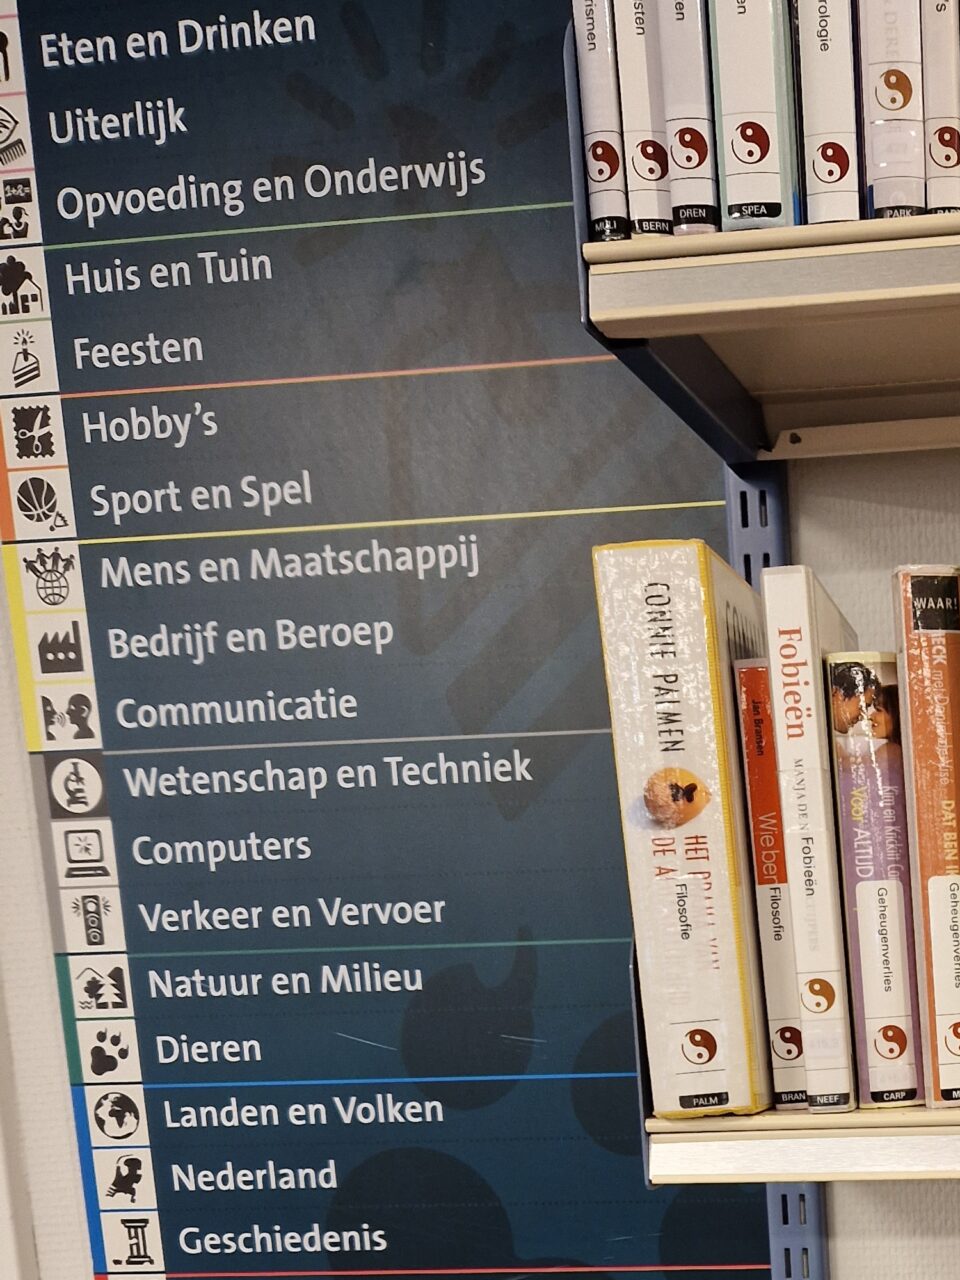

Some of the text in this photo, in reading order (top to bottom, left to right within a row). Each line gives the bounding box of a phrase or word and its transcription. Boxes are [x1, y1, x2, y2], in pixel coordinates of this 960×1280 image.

[41, 10, 315, 67] Eten en Drinken
[49, 98, 187, 145] Uiterlijk
[57, 151, 485, 228] Opvoeding en Onderwijs
[742, 204, 767, 216] SPEA
[680, 207, 706, 219] DREN
[66, 248, 272, 294] Huis en Tuin
[74, 333, 203, 369] Feesten
[91, 470, 311, 525] Sport en Spel
[102, 534, 478, 587] Mens en Maatschappij
[108, 620, 393, 664] Bedrijf en Beroep
[777, 626, 812, 742] Fobieën
[117, 688, 357, 728] Communicatie
[123, 749, 532, 799] Wetenschap en Techniek
[133, 832, 311, 871] Computers
[801, 836, 817, 897] Fobieën
[138, 898, 445, 931] Verkeer en Vervoer
[675, 883, 690, 941] Filosofie
[769, 887, 785, 942] Filosofie
[877, 887, 892, 993] Geheugenverlies
[149, 962, 422, 997] Natuur en Milieu
[156, 1035, 261, 1063] Dieren
[164, 1094, 443, 1127] Landen en Volken
[884, 1092, 906, 1101] CARP
[172, 1160, 337, 1191] Nederland
[179, 1224, 387, 1254] Geschiedenis
